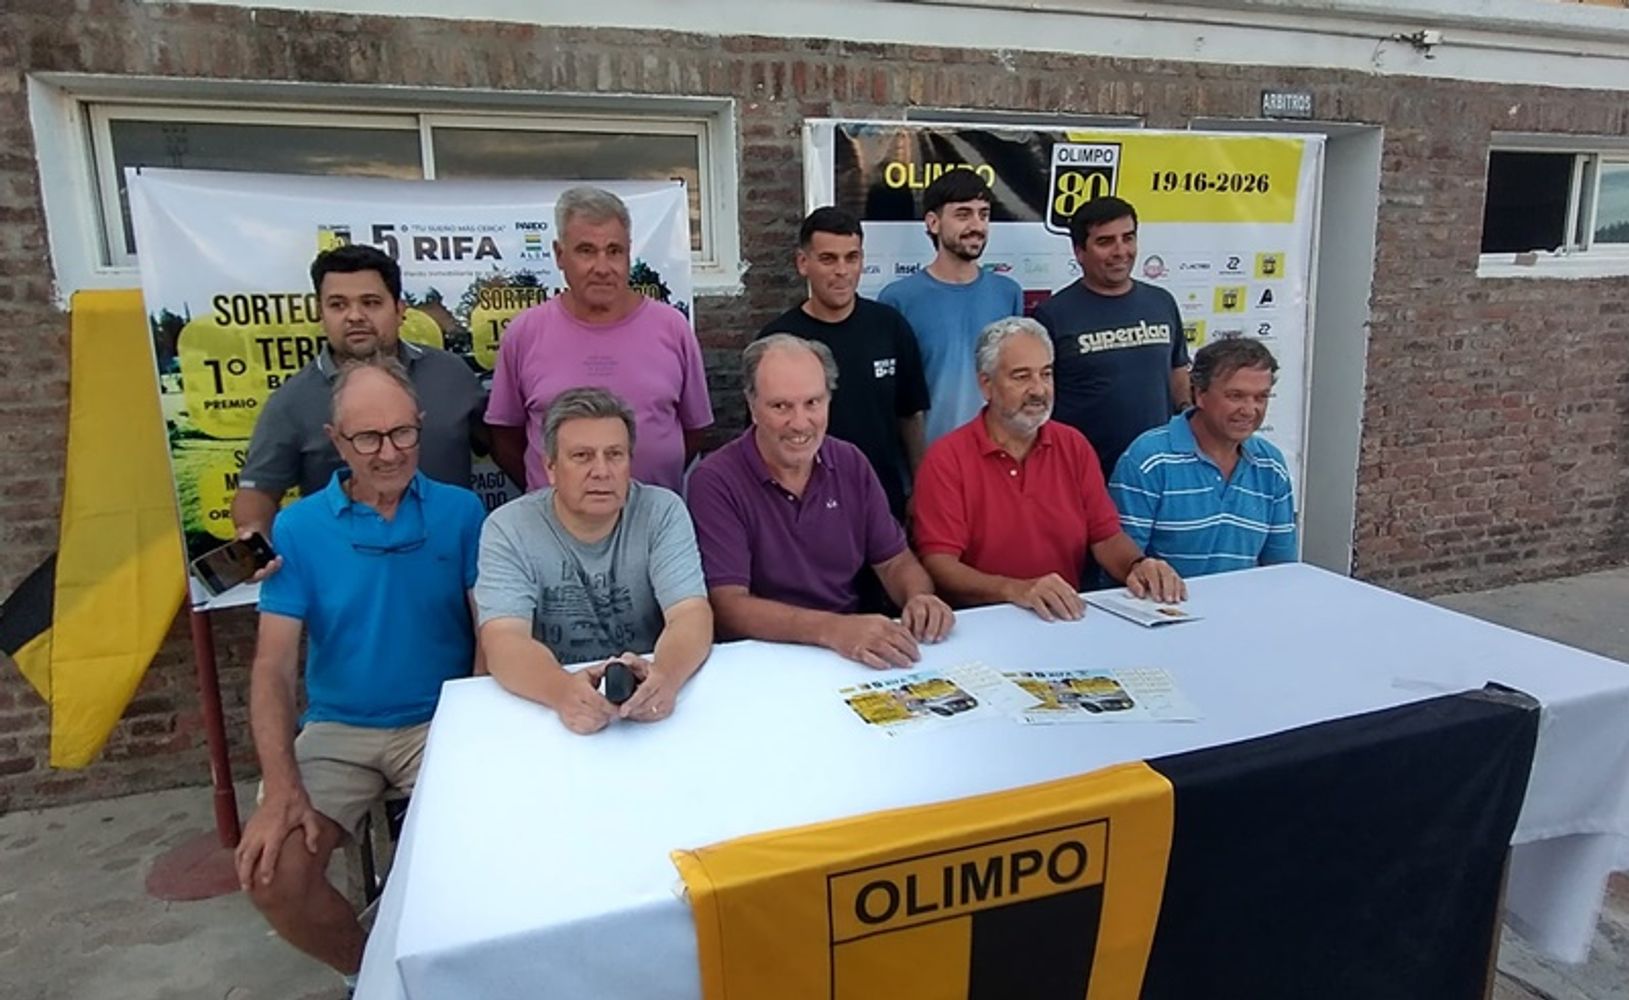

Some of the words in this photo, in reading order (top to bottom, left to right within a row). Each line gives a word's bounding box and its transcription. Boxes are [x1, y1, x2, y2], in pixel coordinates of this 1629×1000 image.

[1057, 147, 1114, 164] OLIMPO
[884, 161, 996, 189] OLIO
[1149, 171, 1270, 193] 1946-2026
[1054, 171, 1110, 216] 80
[413, 235, 503, 261] RIFA
[213, 293, 321, 326] SORTEO
[203, 397, 258, 411] PREMIO
[855, 840, 1089, 925] OLIMPO
